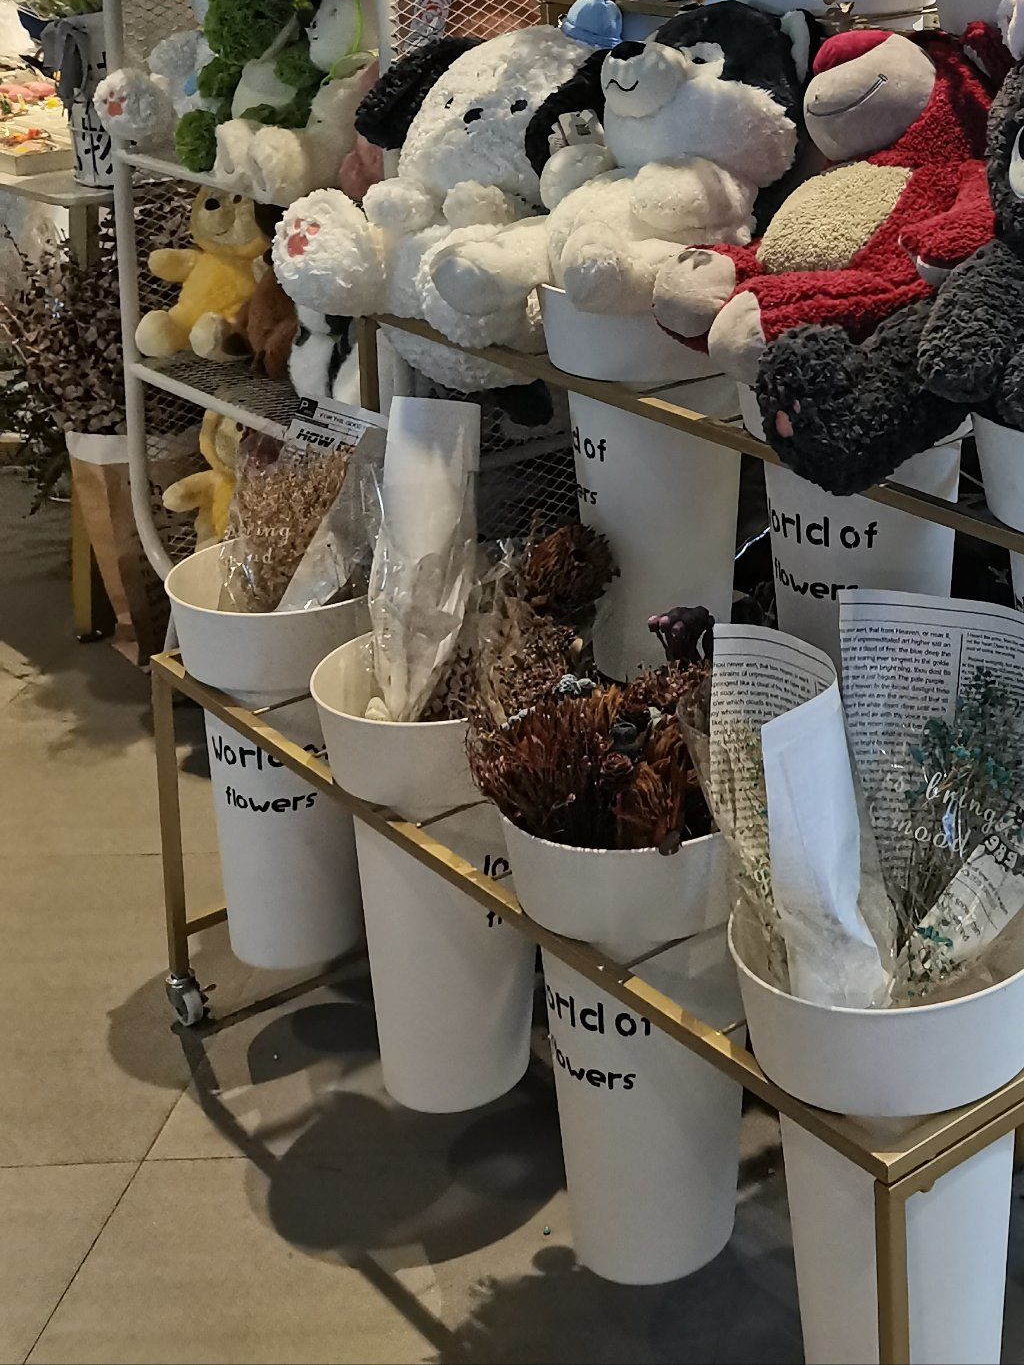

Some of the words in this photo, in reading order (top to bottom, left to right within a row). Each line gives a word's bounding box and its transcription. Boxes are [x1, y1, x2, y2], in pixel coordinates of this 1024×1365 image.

[296, 428, 336, 448] HOW
[584, 437, 607, 462] of
[769, 498, 829, 547] orld
[840, 521, 878, 549] of
[226, 786, 318, 812] flowers
[925, 771, 996, 834] bring
[552, 1036, 637, 1090] lowers
